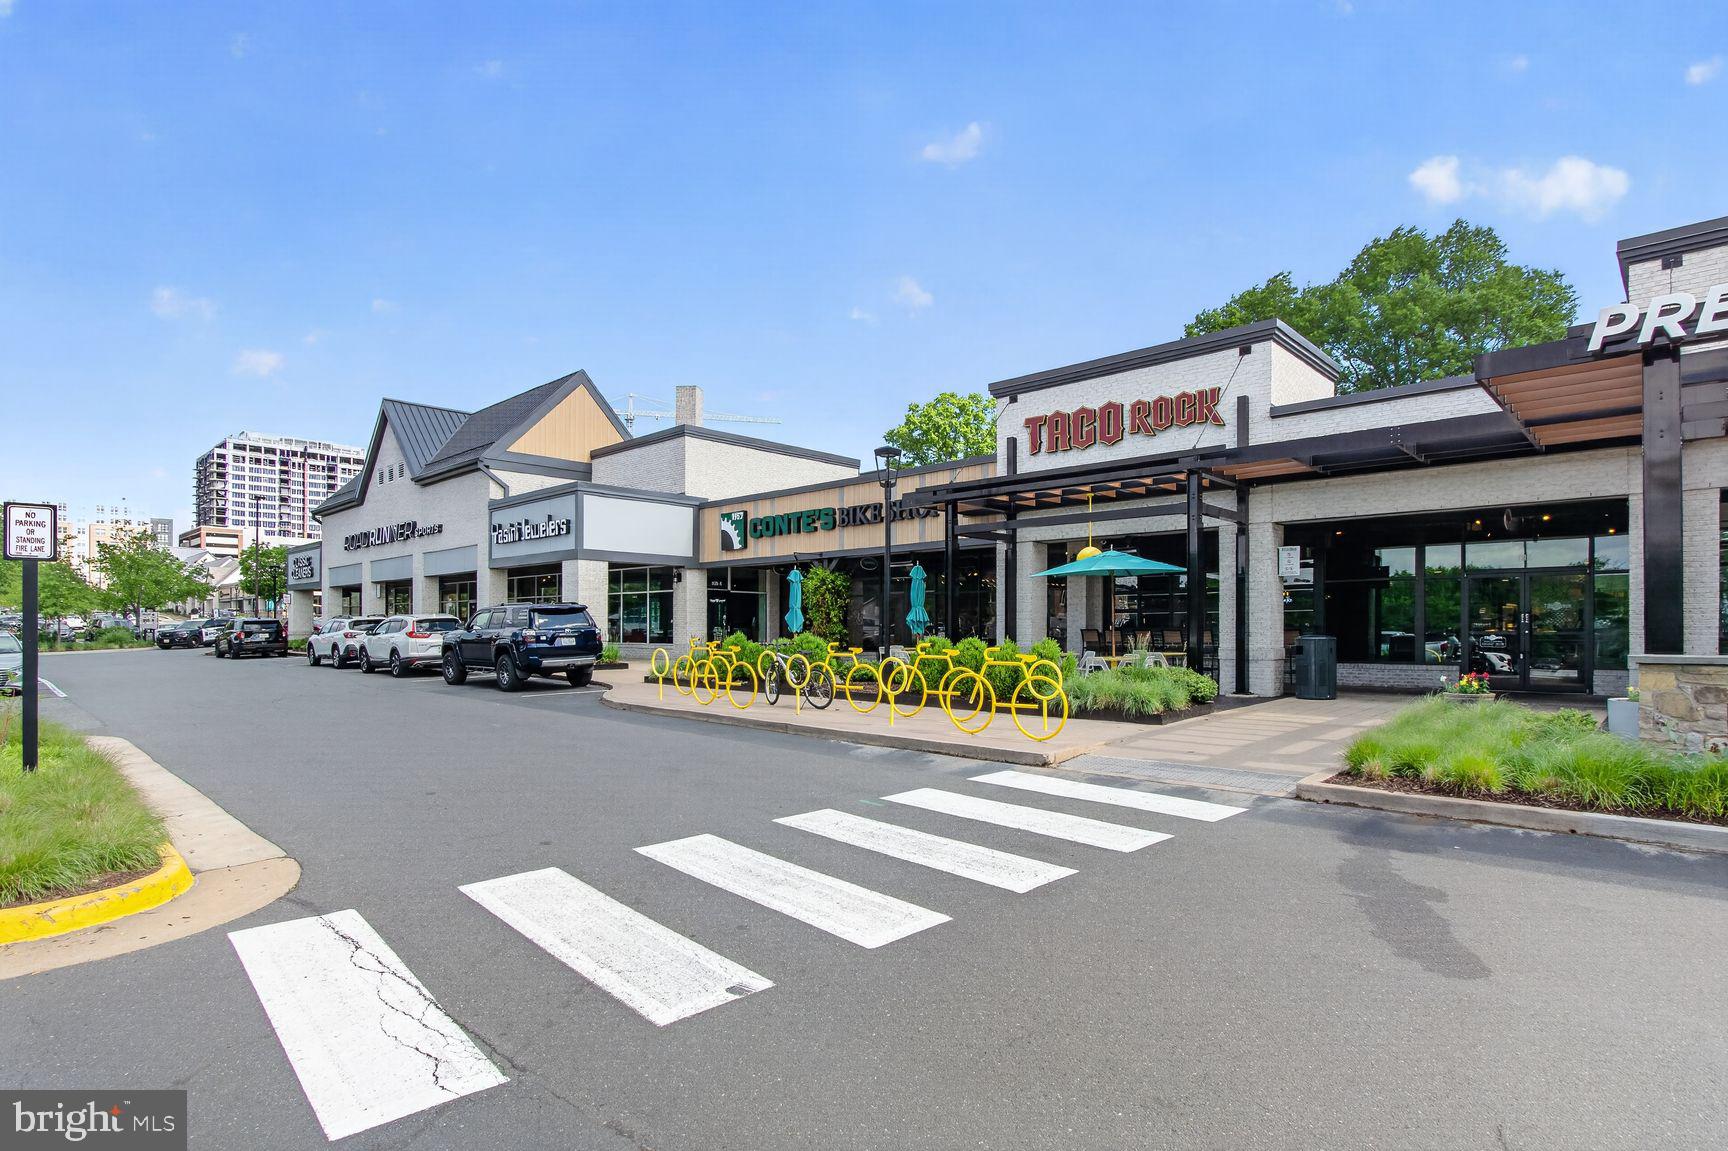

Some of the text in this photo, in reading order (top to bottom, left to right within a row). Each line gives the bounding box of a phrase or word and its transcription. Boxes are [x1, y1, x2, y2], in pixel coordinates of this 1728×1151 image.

[1587, 283, 1728, 352] PRE
[1024, 386, 1226, 456] TACO ROCK
[25, 511, 36, 519] NO
[749, 507, 837, 539] CONTE'S
[837, 502, 883, 528] BIKE
[15, 519, 47, 528] PARKING
[520, 515, 570, 540] Jewelers
[25, 528, 35, 536] OR
[415, 523, 442, 538] SPORTS
[15, 536, 46, 544] STANDING
[15, 544, 45, 553] FIRE LANE
